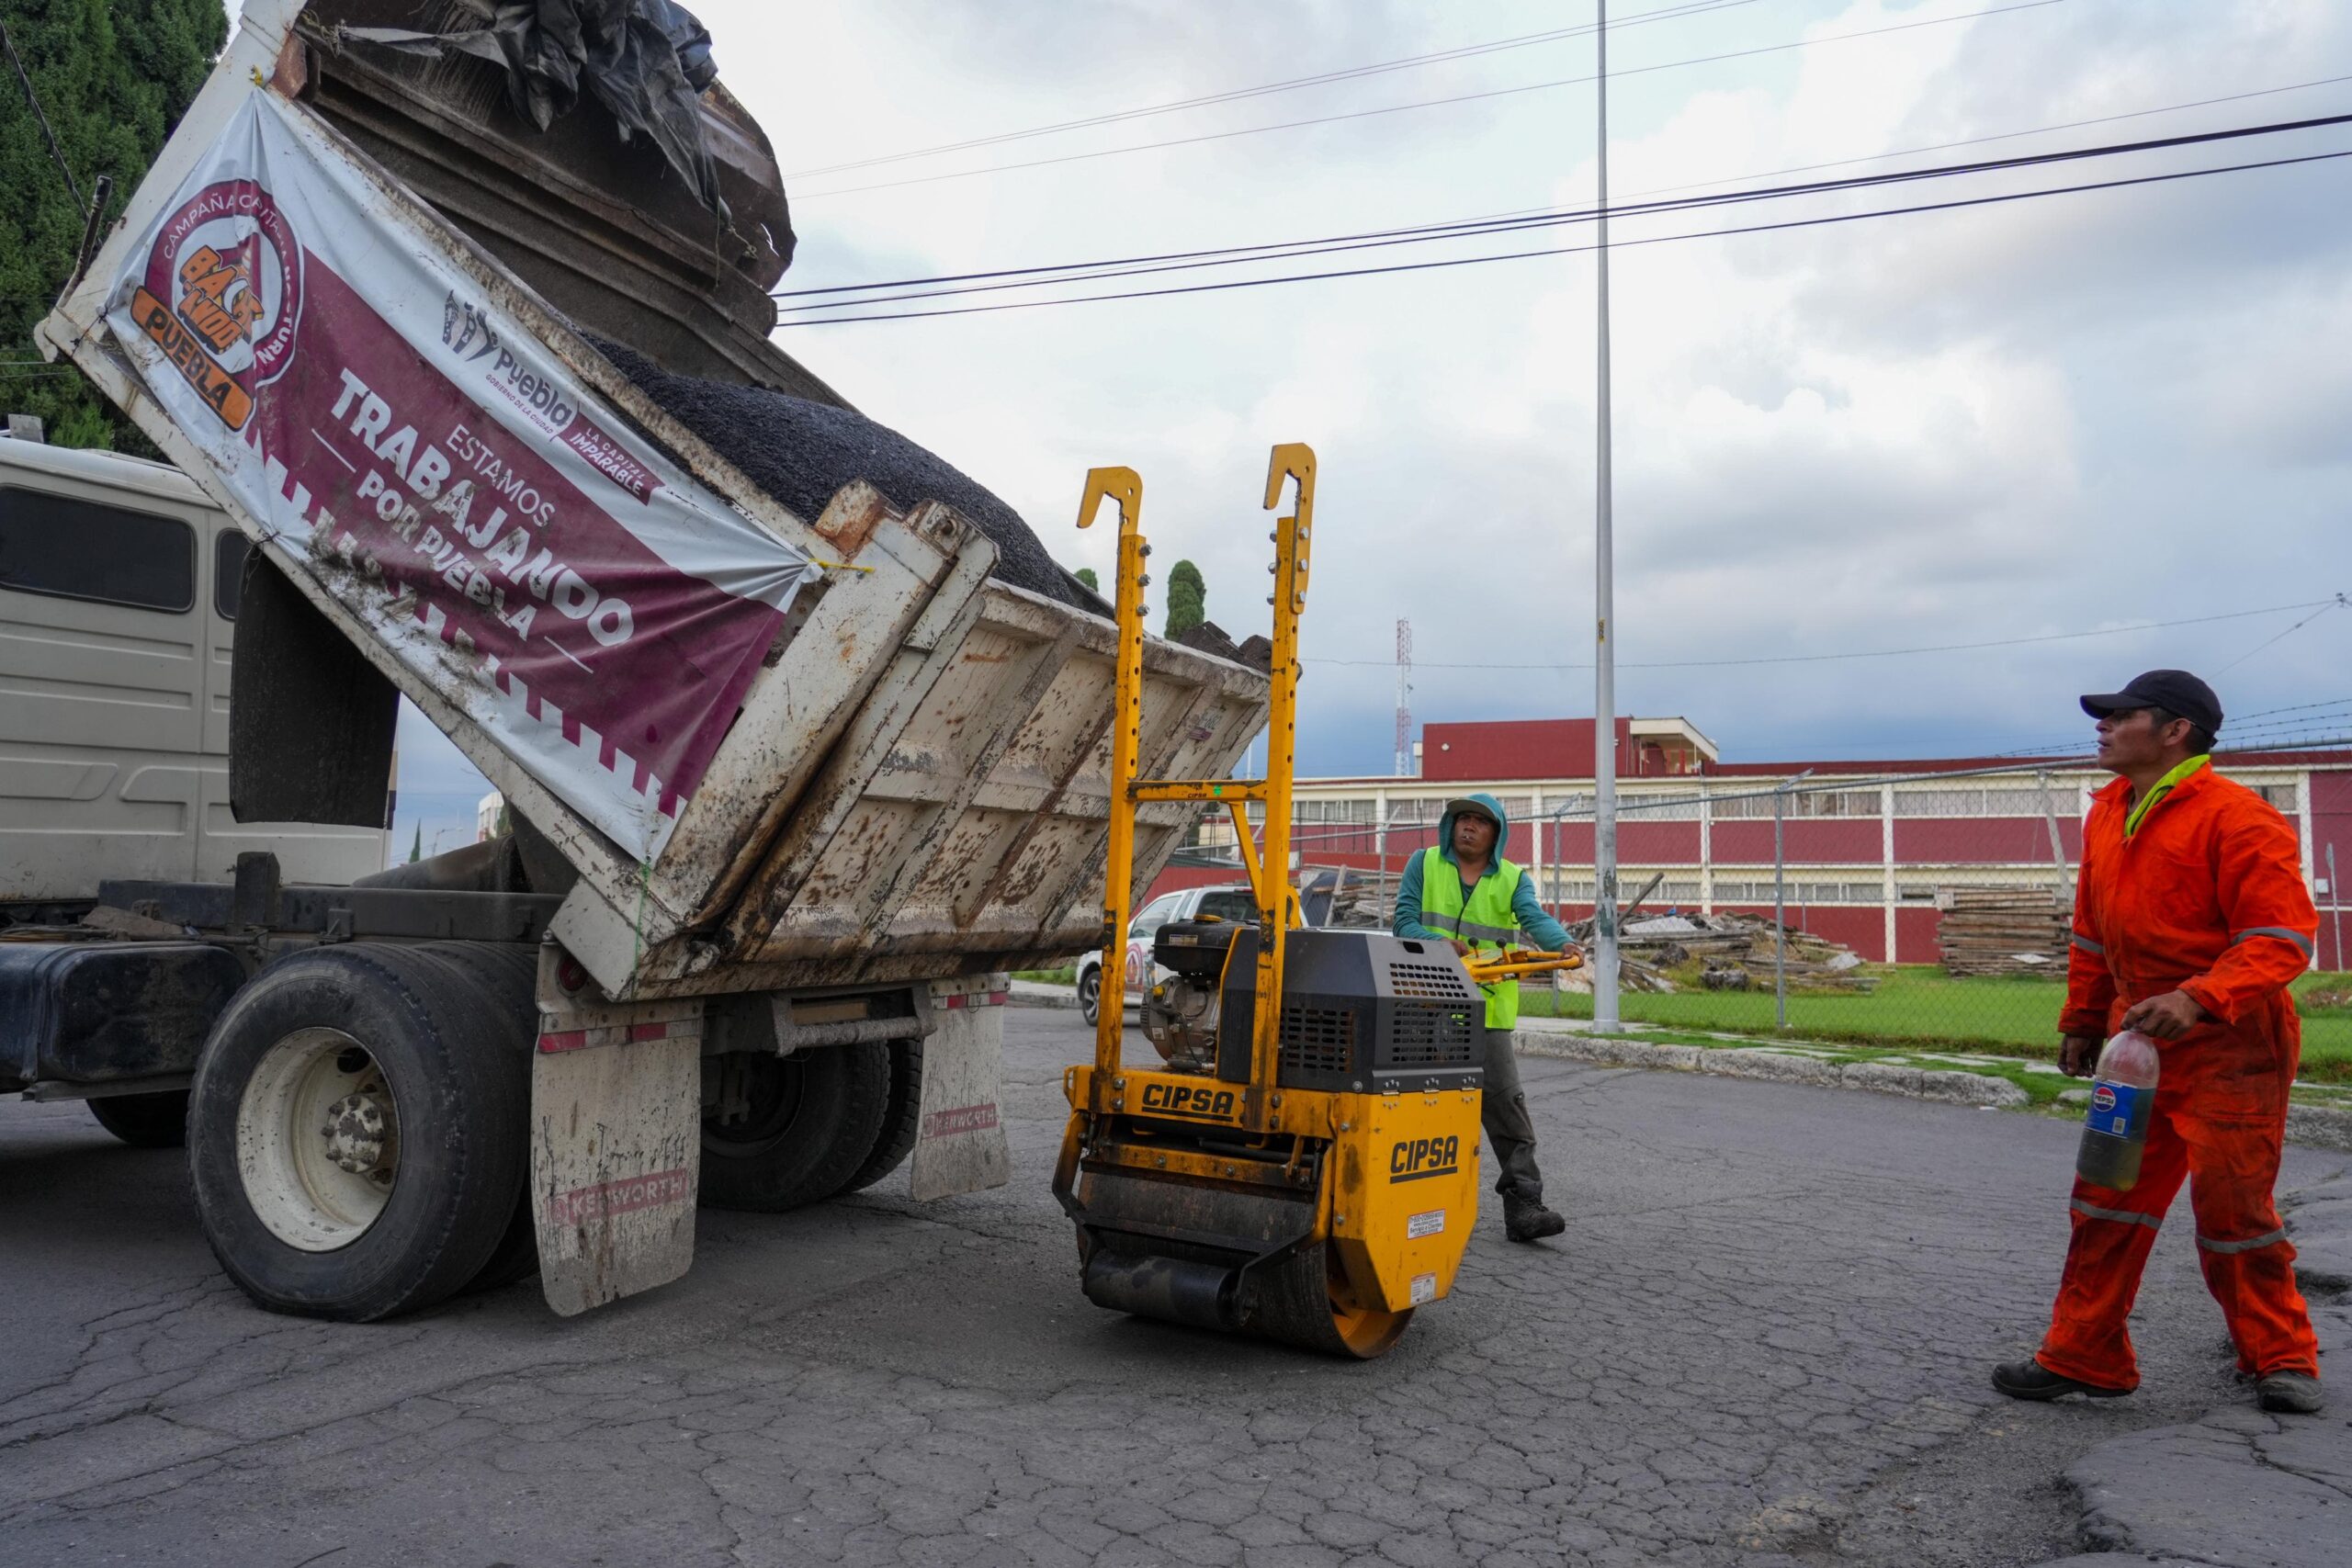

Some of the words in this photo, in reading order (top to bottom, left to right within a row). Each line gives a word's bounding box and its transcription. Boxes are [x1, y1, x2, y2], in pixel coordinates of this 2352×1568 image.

[164, 192, 235, 259] CAMPAÑA
[146, 306, 232, 412] PUEBLA
[485, 373, 516, 401] GOBIERNO
[514, 400, 525, 409] DE
[522, 407, 531, 417] LA
[530, 413, 554, 434] CIUDAD
[446, 423, 556, 528] ESTAMOS
[570, 432, 644, 496] IMPARABLE
[586, 427, 600, 444] LA
[602, 442, 646, 479] CAPITAL
[330, 367, 635, 647] TRABAJANDO
[356, 469, 423, 544] POR
[413, 525, 537, 642] PUEBLA
[1142, 1083, 1235, 1115] CIPSA
[1390, 1135, 1459, 1174] CIPSA
